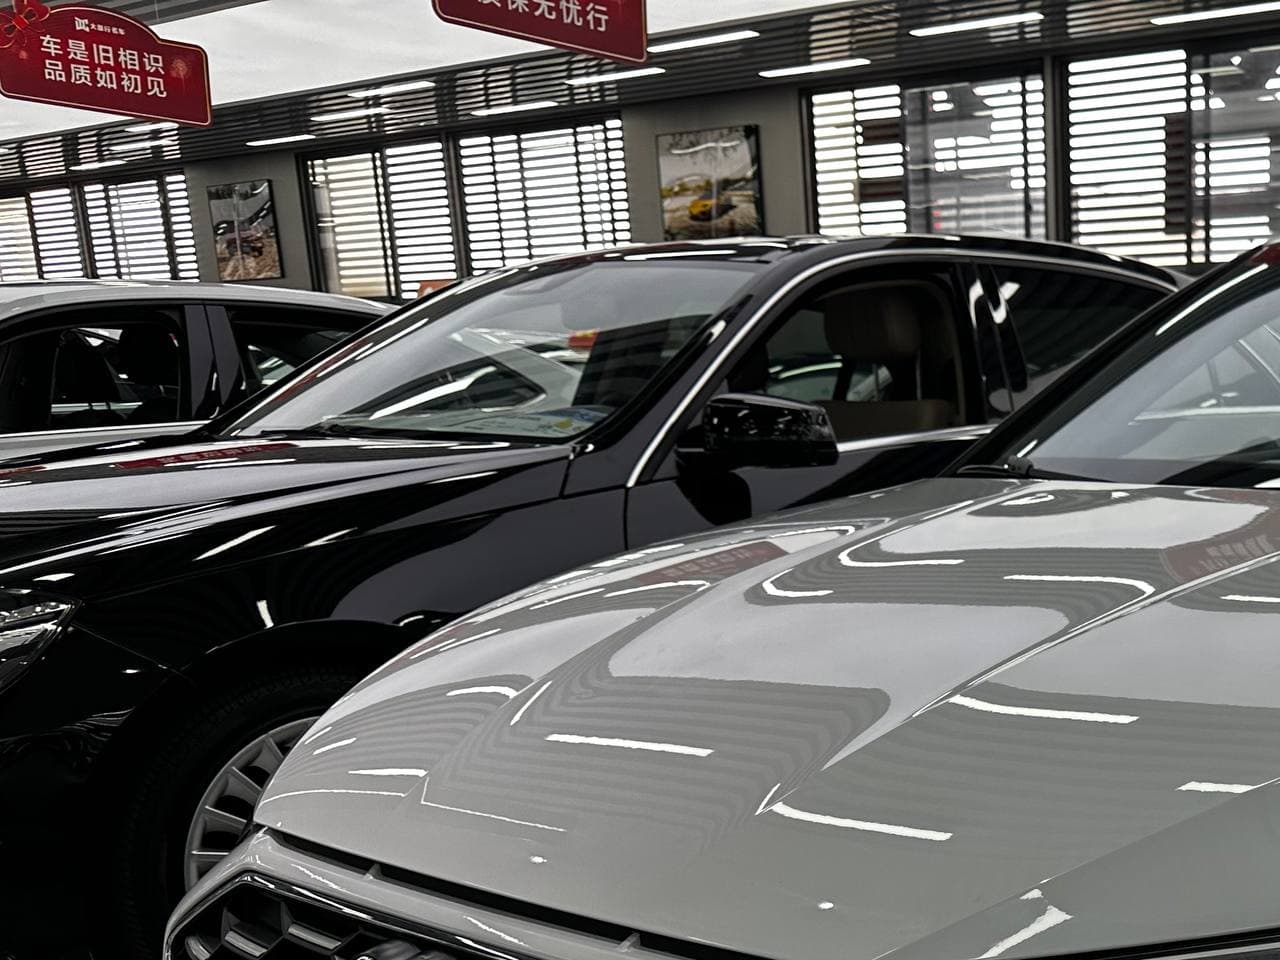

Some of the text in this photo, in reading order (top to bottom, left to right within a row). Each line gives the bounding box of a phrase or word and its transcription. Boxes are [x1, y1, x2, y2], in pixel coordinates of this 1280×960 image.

[478, 0, 609, 32] 无忧行
[40, 35, 165, 75] 车是旧相识
[44, 59, 168, 98] 品质如初见
